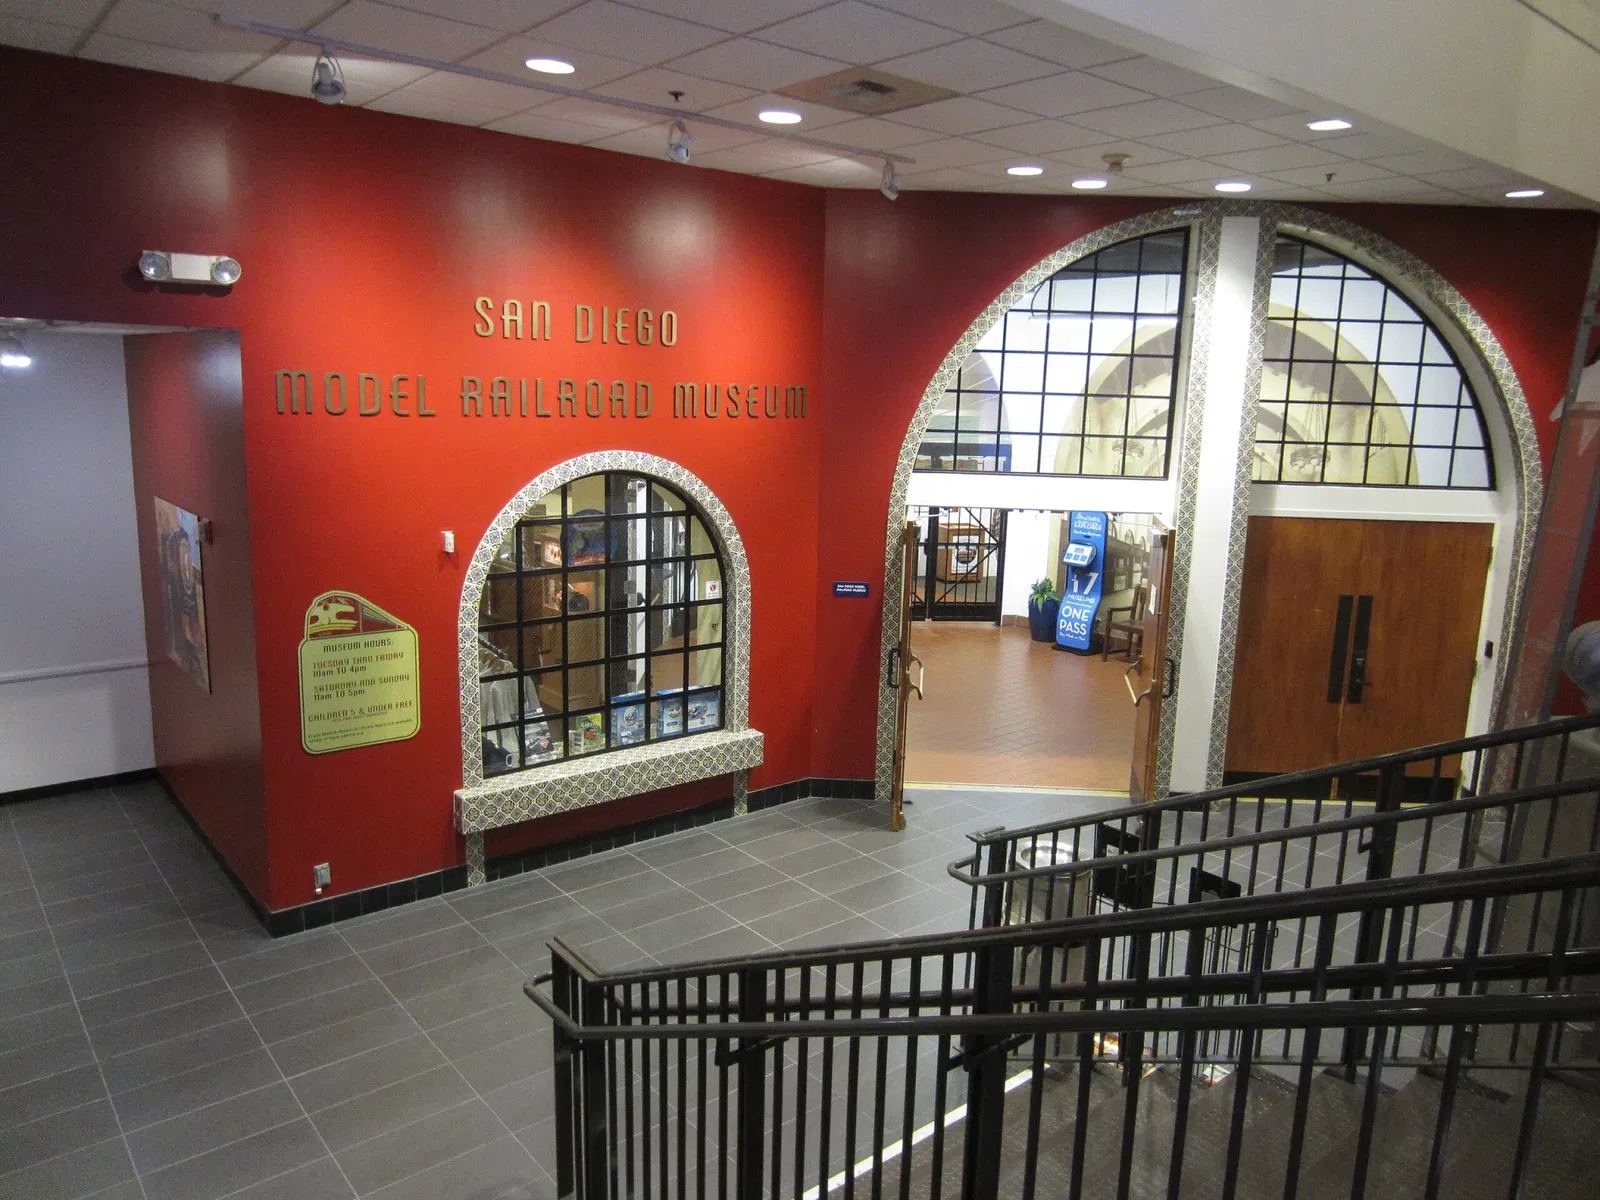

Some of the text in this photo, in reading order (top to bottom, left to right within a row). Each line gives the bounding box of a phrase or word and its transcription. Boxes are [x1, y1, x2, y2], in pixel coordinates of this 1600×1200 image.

[474, 296, 678, 347] SAN DIEGO
[275, 369, 808, 419] MODEL RAILROAD MUSEUM
[1071, 572, 1099, 595] 17
[1068, 593, 1096, 604] MUSEUMS
[1061, 605, 1092, 621] ONE
[1059, 619, 1087, 636] PASS
[323, 641, 361, 653] MUSEUM
[313, 652, 404, 669] TUESDAY THRU FRIDAY
[313, 665, 367, 677] 10am TO 4pm
[313, 674, 410, 693] SATURDAY AND SUNDAY
[314, 688, 365, 700] 11am TO 5pm
[308, 709, 348, 722] CHILDREN
[350, 708, 356, 716] 5
[367, 703, 393, 713] UNDER
[395, 700, 412, 709] FREE
